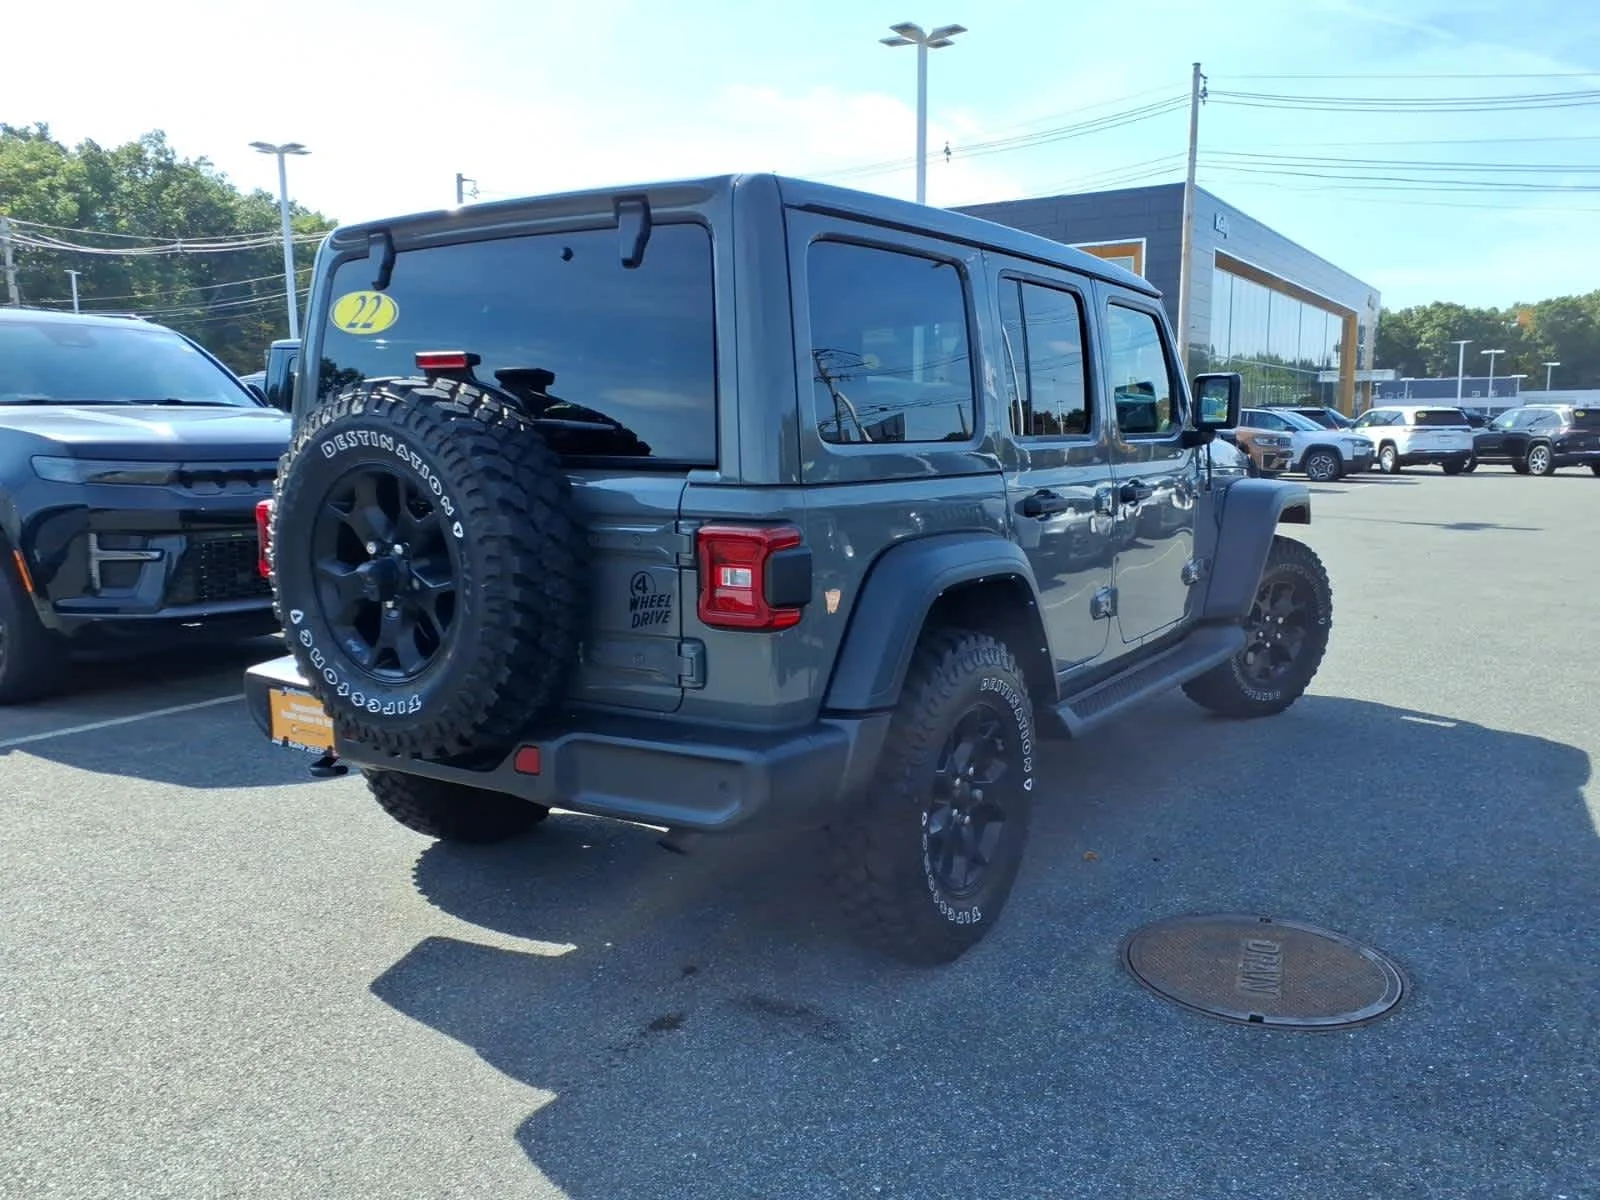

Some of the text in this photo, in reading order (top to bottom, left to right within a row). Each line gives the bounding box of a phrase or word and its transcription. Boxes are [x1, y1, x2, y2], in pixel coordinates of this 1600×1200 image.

[345, 295, 382, 329] 22
[320, 430, 455, 516] DESTINATION
[634, 575, 649, 595] 4
[630, 594, 672, 613] WHEEL
[631, 610, 671, 628] DRIVE
[1241, 939, 1280, 995] DRAIN
